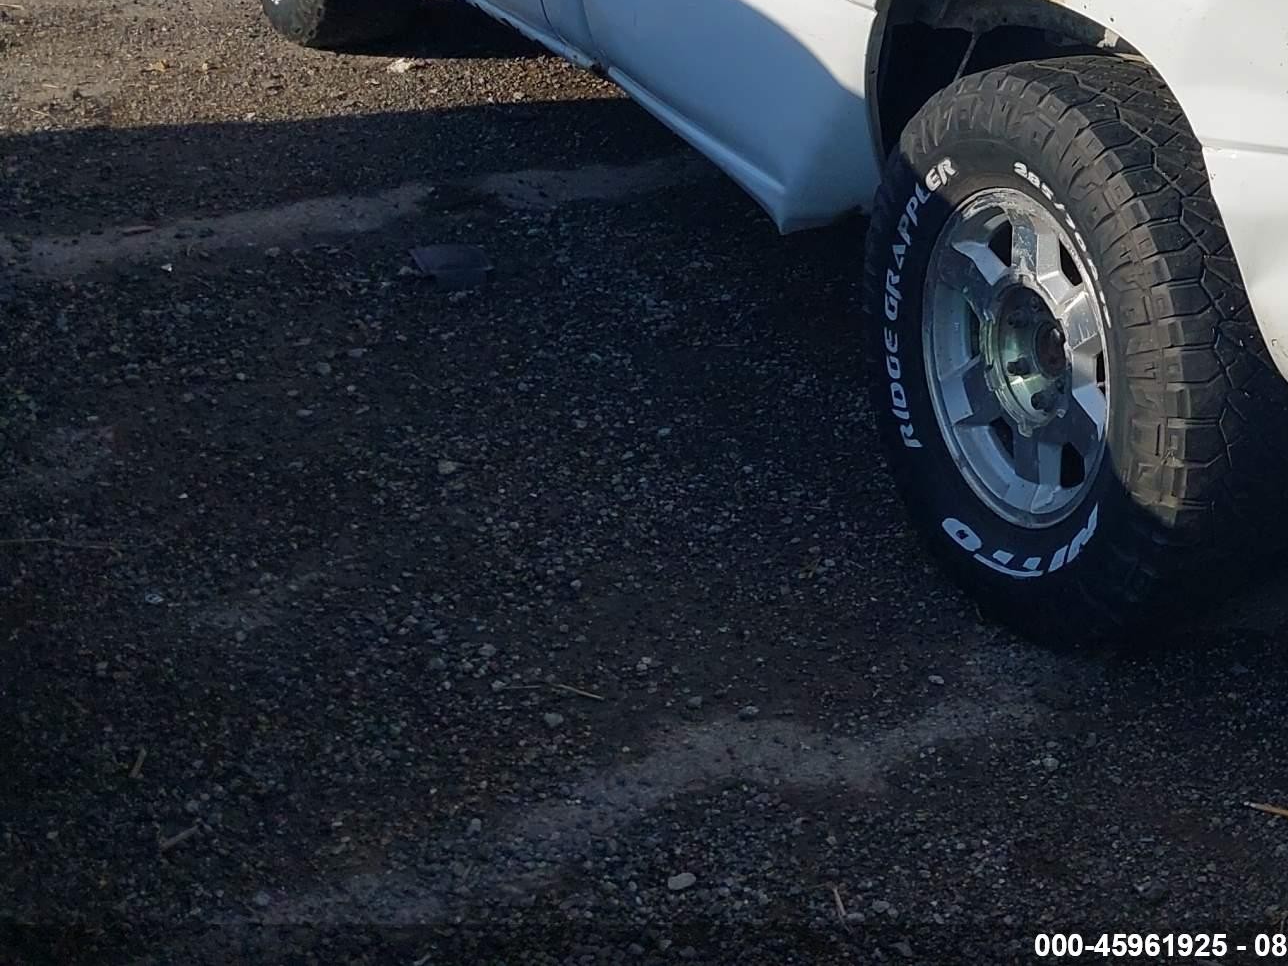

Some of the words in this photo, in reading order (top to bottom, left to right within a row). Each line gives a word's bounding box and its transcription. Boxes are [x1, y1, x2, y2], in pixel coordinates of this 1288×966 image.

[884, 156, 960, 322] GRAPPLER
[884, 326, 923, 448] RIDGE
[941, 500, 1099, 577] NITTO
